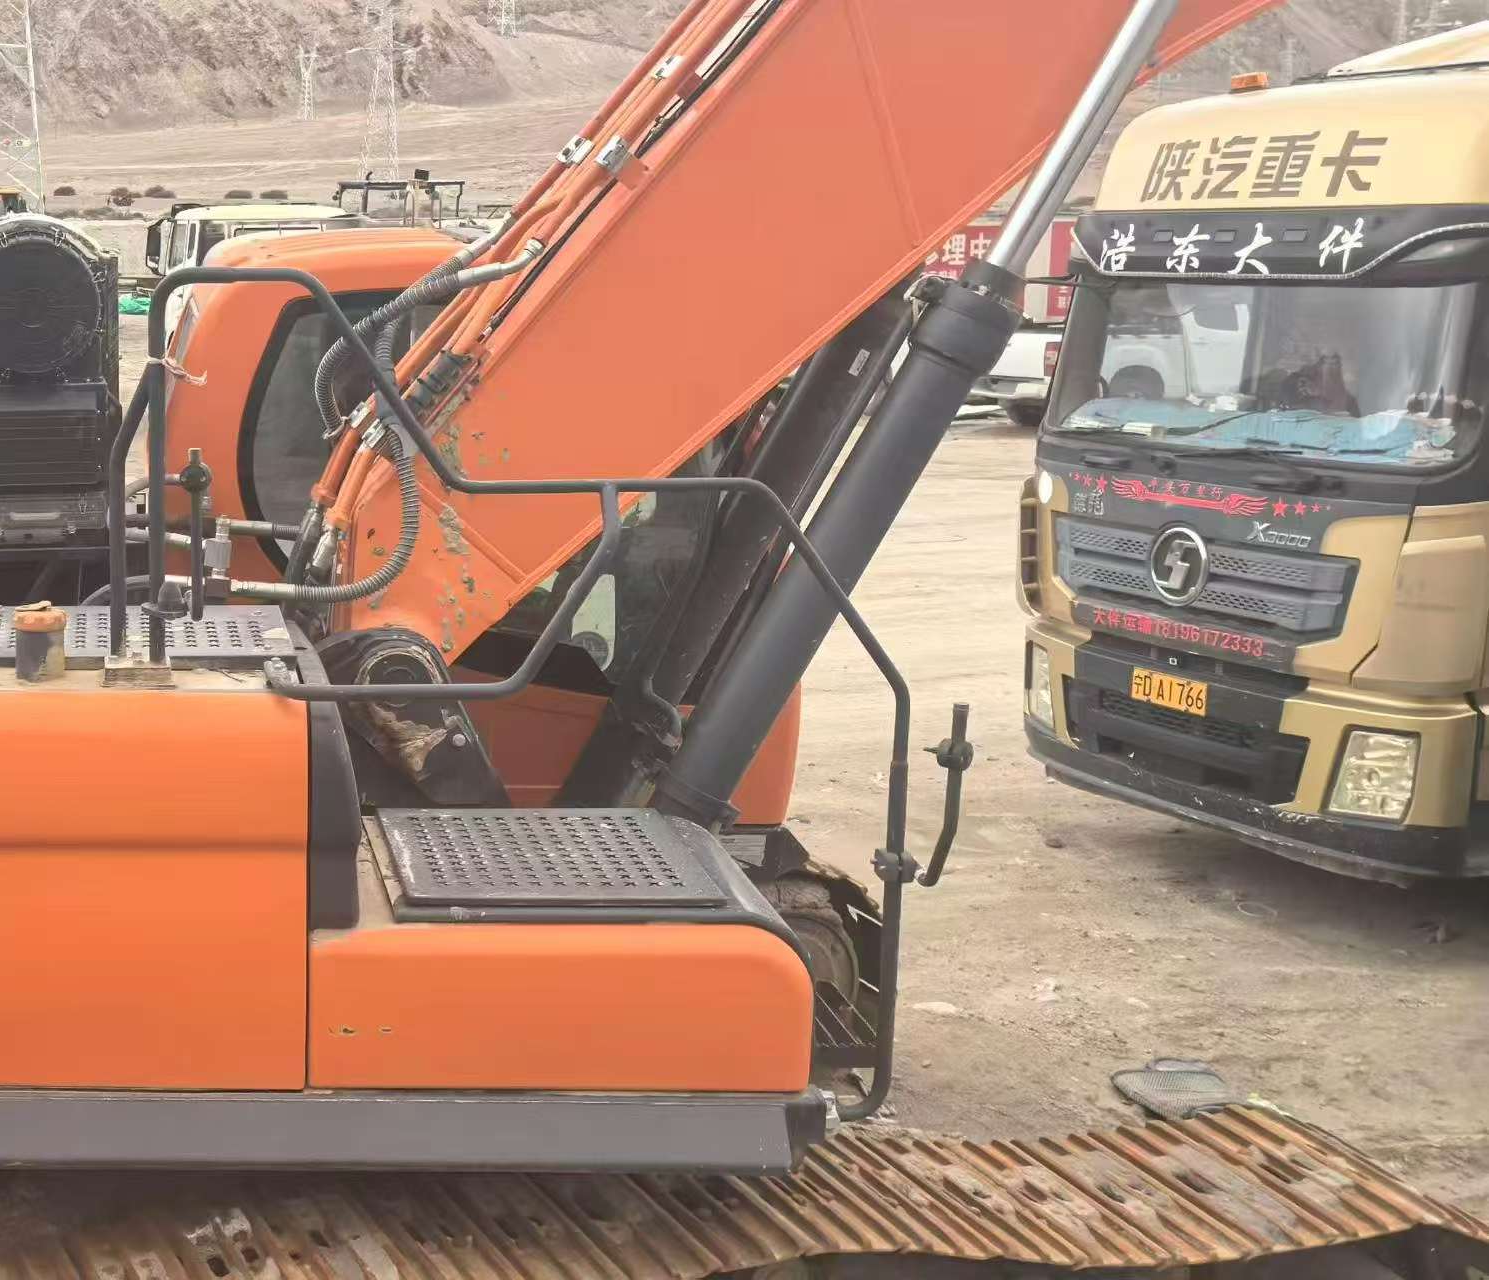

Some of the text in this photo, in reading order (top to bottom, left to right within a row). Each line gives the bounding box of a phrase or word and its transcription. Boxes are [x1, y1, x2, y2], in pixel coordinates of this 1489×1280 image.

[1141, 130, 1388, 202] 陕汽重卡
[925, 232, 992, 266] 理中
